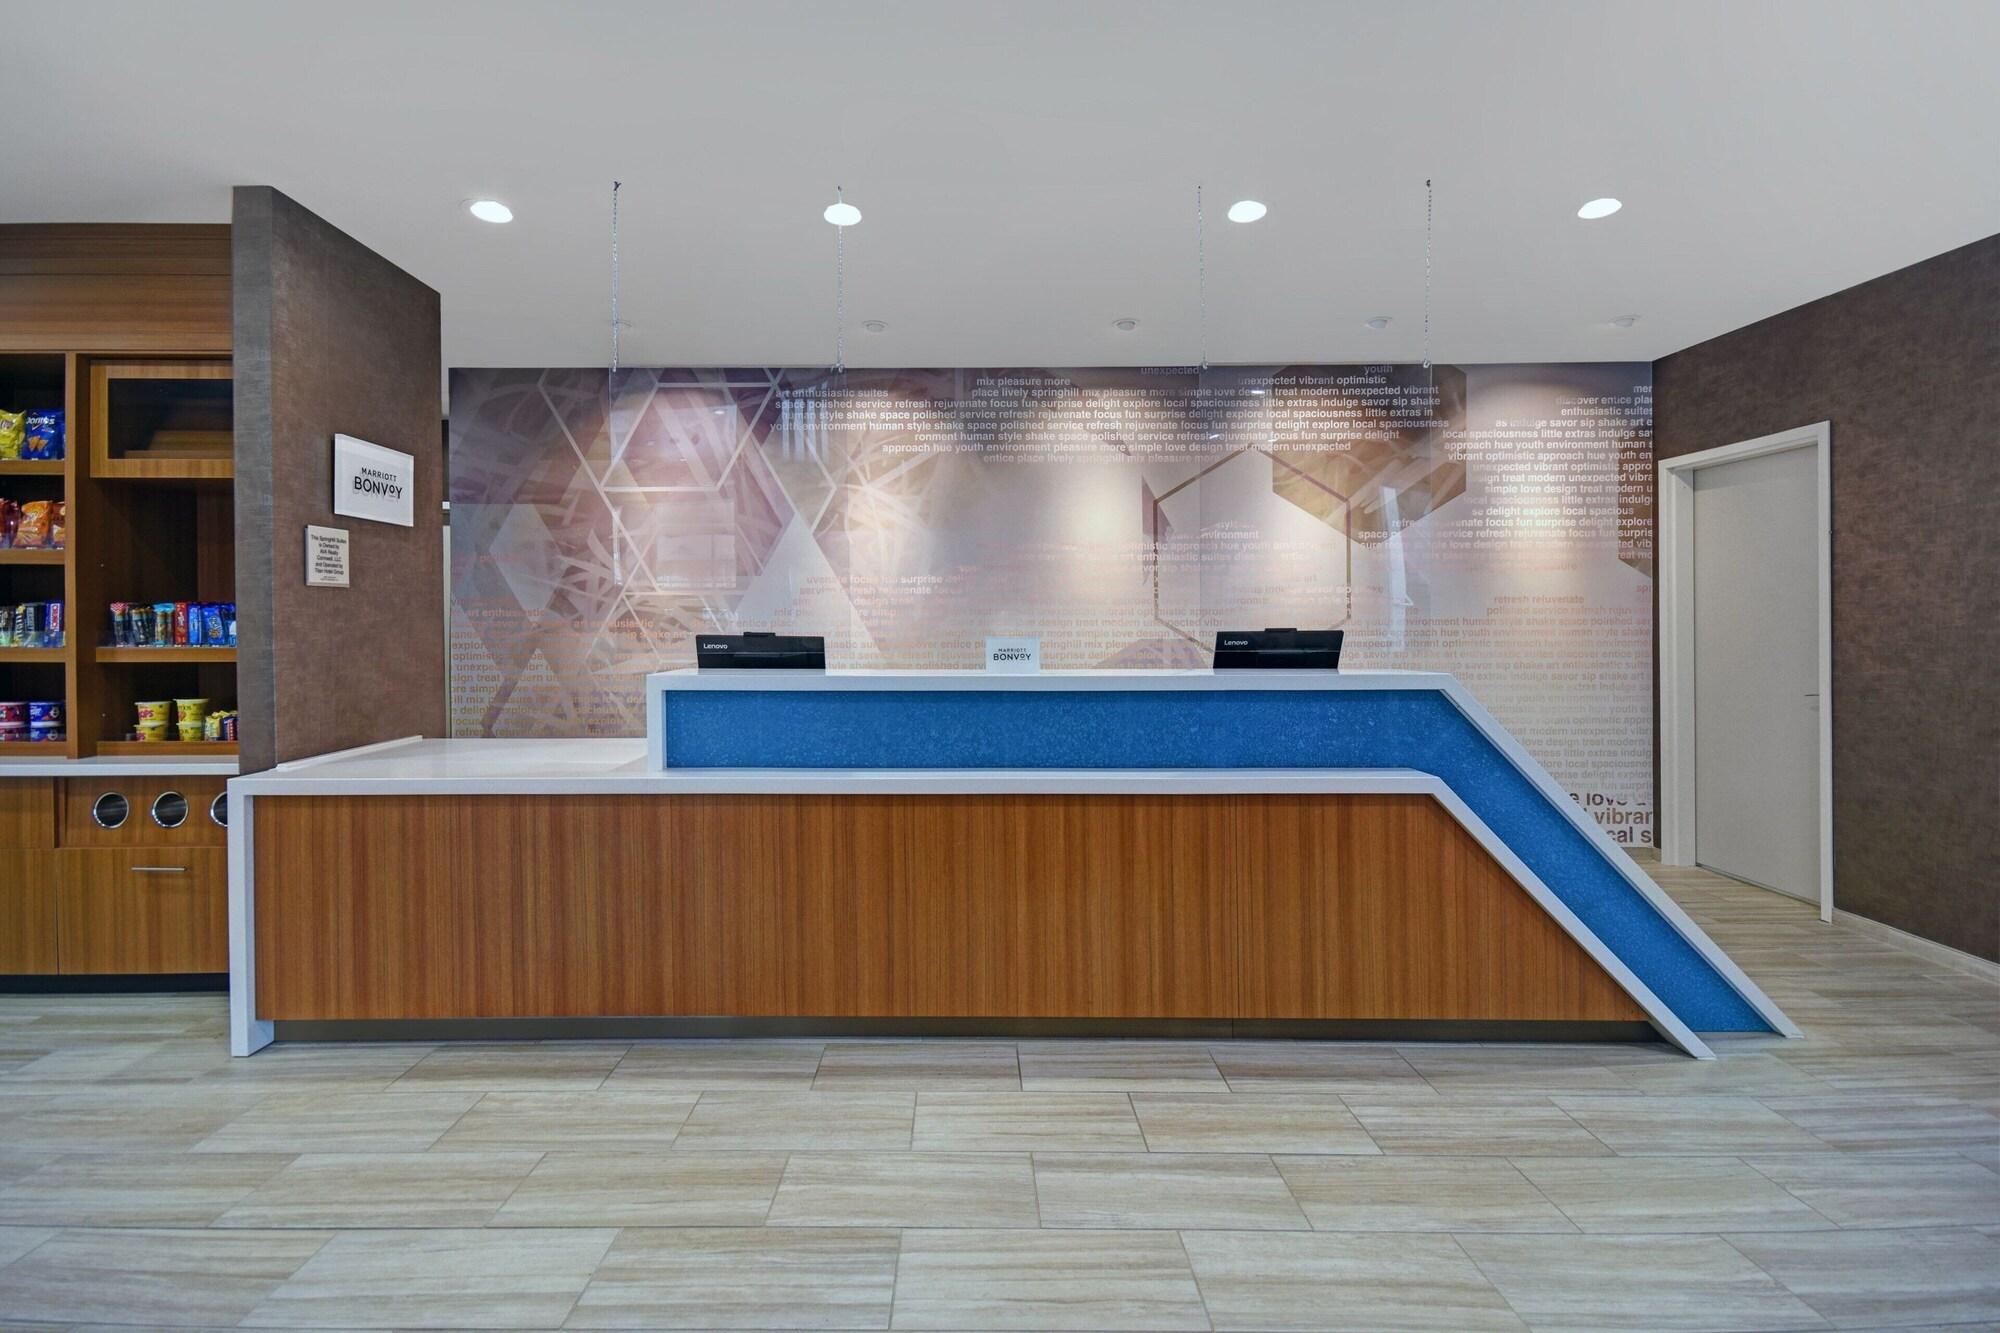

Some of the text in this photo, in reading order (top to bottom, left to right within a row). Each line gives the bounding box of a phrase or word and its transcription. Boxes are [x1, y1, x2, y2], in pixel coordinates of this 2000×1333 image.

[977, 378, 1071, 387] mix pleasure more
[1238, 376, 1386, 386] unexpected vibrant optimistic
[793, 388, 854, 398] enthusiastic
[858, 388, 888, 398] suites
[972, 388, 999, 398] place
[1002, 388, 1030, 398] lively
[1032, 388, 1079, 398] springhill
[1082, 388, 1100, 396] mix
[1102, 388, 1146, 398] pleasure
[1214, 388, 1235, 396] love
[1275, 388, 1298, 396] treat
[1300, 387, 1340, 396] modern
[1342, 386, 1400, 396] unexpected
[1404, 386, 1439, 394] vibrant
[810, 400, 852, 410] polished
[856, 400, 892, 408] service
[895, 400, 931, 408] refresh
[934, 400, 986, 410] rejuvenate
[990, 399, 1018, 408] focus
[1022, 399, 1038, 408] fun
[1042, 399, 1084, 410] surprise
[1086, 399, 1120, 410] delight
[1122, 399, 1160, 409] explore
[1164, 399, 1187, 408] local
[1190, 399, 1260, 409] spaciousness
[1263, 398, 1284, 407] little
[1287, 398, 1318, 406] extras
[1321, 398, 1358, 408] indulge
[1361, 398, 1390, 406] savor
[1392, 398, 1408, 407] sip
[1410, 397, 1440, 406] shake
[846, 411, 876, 420] shake
[880, 412, 910, 422] space
[912, 410, 956, 421] polished
[960, 410, 996, 418] service
[1000, 410, 1035, 418] refresh
[1038, 410, 1091, 421] rejuvenate
[1094, 410, 1122, 418] focus
[1125, 410, 1142, 418] fun
[1144, 410, 1186, 420] surprise
[1189, 410, 1224, 420] delight
[1226, 410, 1264, 420] explore
[1266, 410, 1290, 418] local
[1293, 409, 1362, 419] spaciousness
[1366, 409, 1386, 417] little
[1424, 408, 1433, 416] in
[1561, 407, 1622, 416] enthusiastic
[804, 422, 866, 431] environment
[870, 422, 904, 430] human
[906, 422, 932, 432] style
[934, 422, 964, 430] shake
[967, 422, 998, 432] space
[1000, 421, 1044, 431] polished
[1048, 421, 1084, 430] service
[1086, 421, 1122, 430] refresh
[1125, 420, 1178, 431] rejuvenate
[1181, 420, 1208, 430] focus
[1212, 420, 1228, 429] fun
[1232, 420, 1272, 430] surprise
[1275, 420, 1310, 430] delight
[1312, 420, 1350, 430] explore
[1352, 420, 1376, 428] local
[1380, 419, 1449, 430] spaciousness
[1550, 419, 1578, 428] savor
[1580, 418, 1596, 428] sip
[1598, 418, 1628, 426] shake
[1630, 418, 1644, 426] art
[1470, 430, 1538, 440] spaciousness
[1542, 430, 1562, 438] little
[1566, 430, 1596, 438] extras
[1599, 429, 1636, 440] indulge
[1444, 440, 1646, 452] approach hue youth environment human
[1448, 451, 1636, 462] vibrant optimistic approach hue youth
[1534, 463, 1568, 472] vibrant
[362, 468, 396, 482] MARRIOTT
[1502, 473, 1626, 483] treat modern unexpected
[354, 476, 402, 499] BONVOY
[1520, 484, 1541, 493] love
[1544, 484, 1577, 495] design
[1605, 484, 1644, 493] modern
[1486, 507, 1520, 517] delight
[900, 575, 943, 586] surprise
[703, 642, 728, 650] Lenovo
[993, 653, 1032, 661] BONVOY
